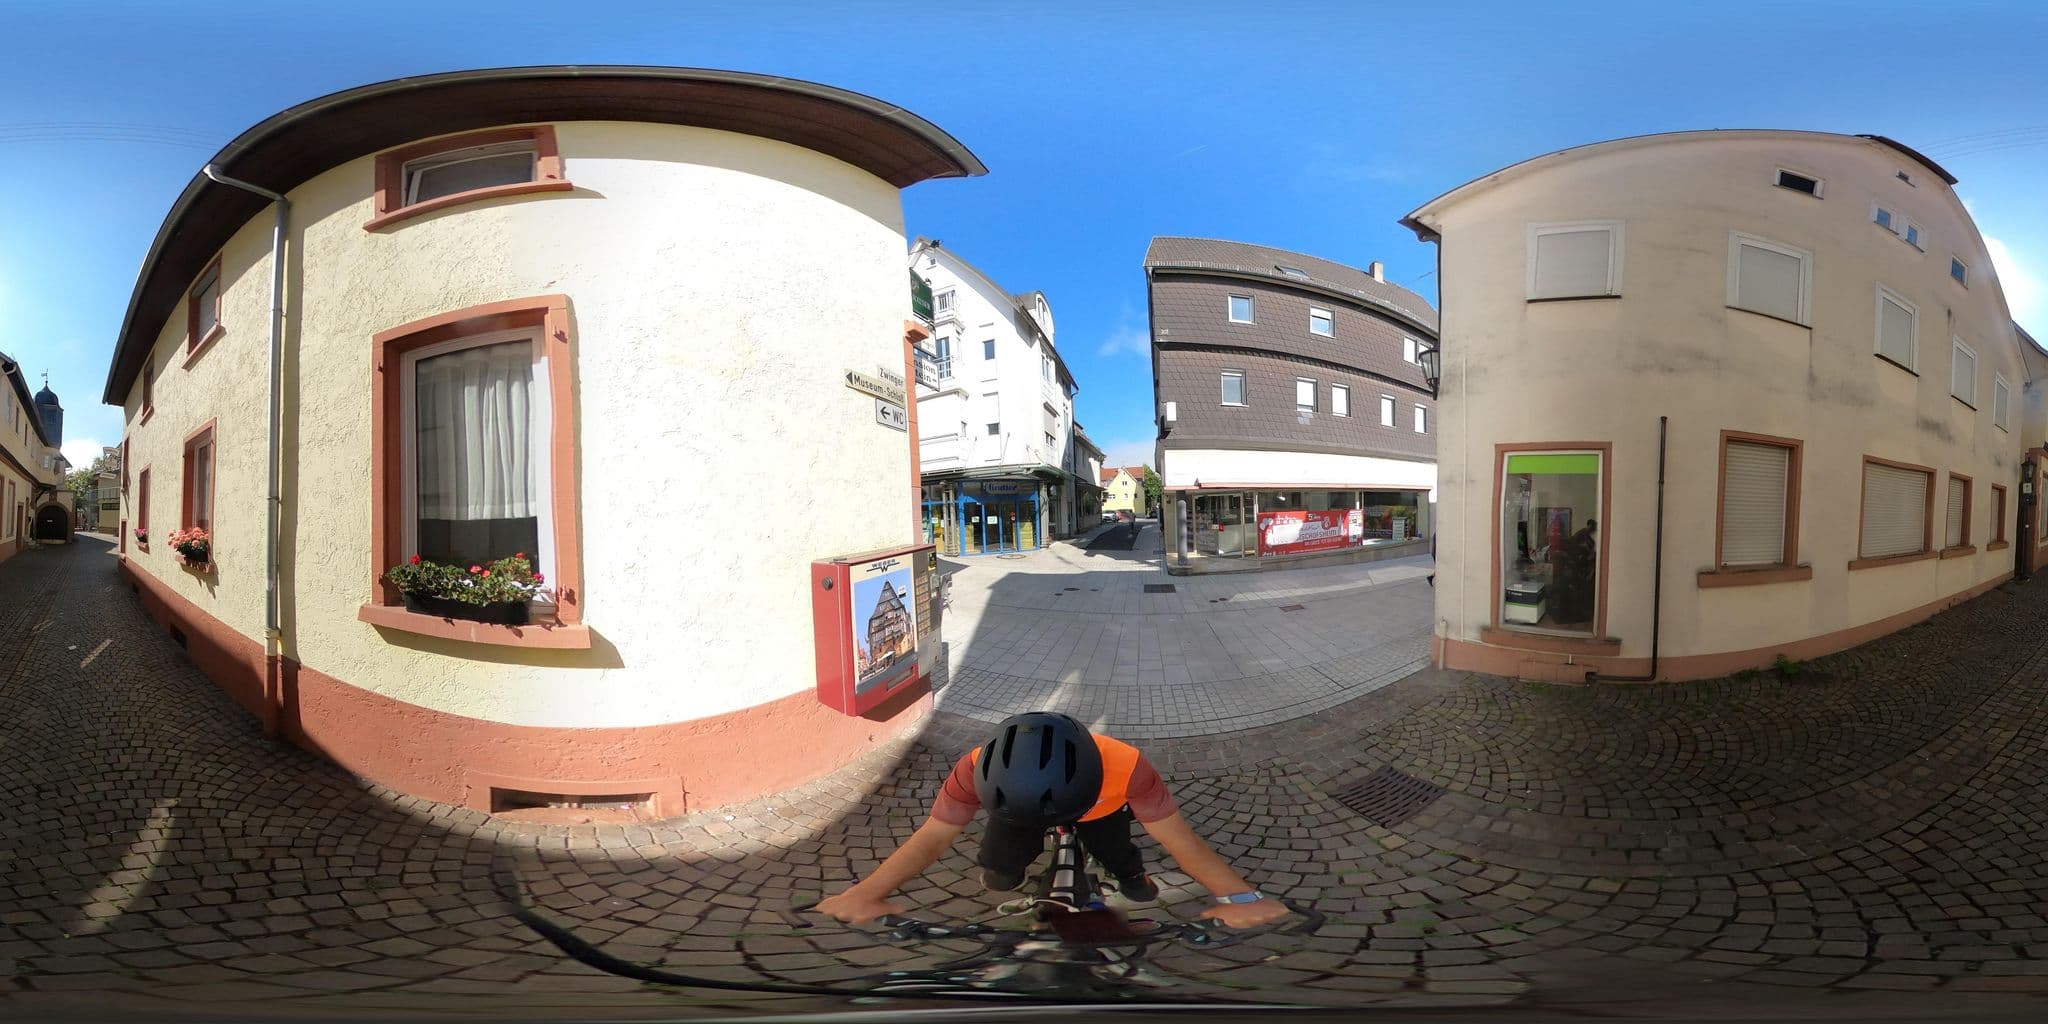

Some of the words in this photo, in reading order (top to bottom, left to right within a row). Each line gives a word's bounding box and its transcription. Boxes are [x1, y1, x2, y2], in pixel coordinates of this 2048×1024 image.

[879, 367, 904, 387] Zwinger
[892, 409, 904, 425] WC
[872, 559, 896, 569] WEBER
